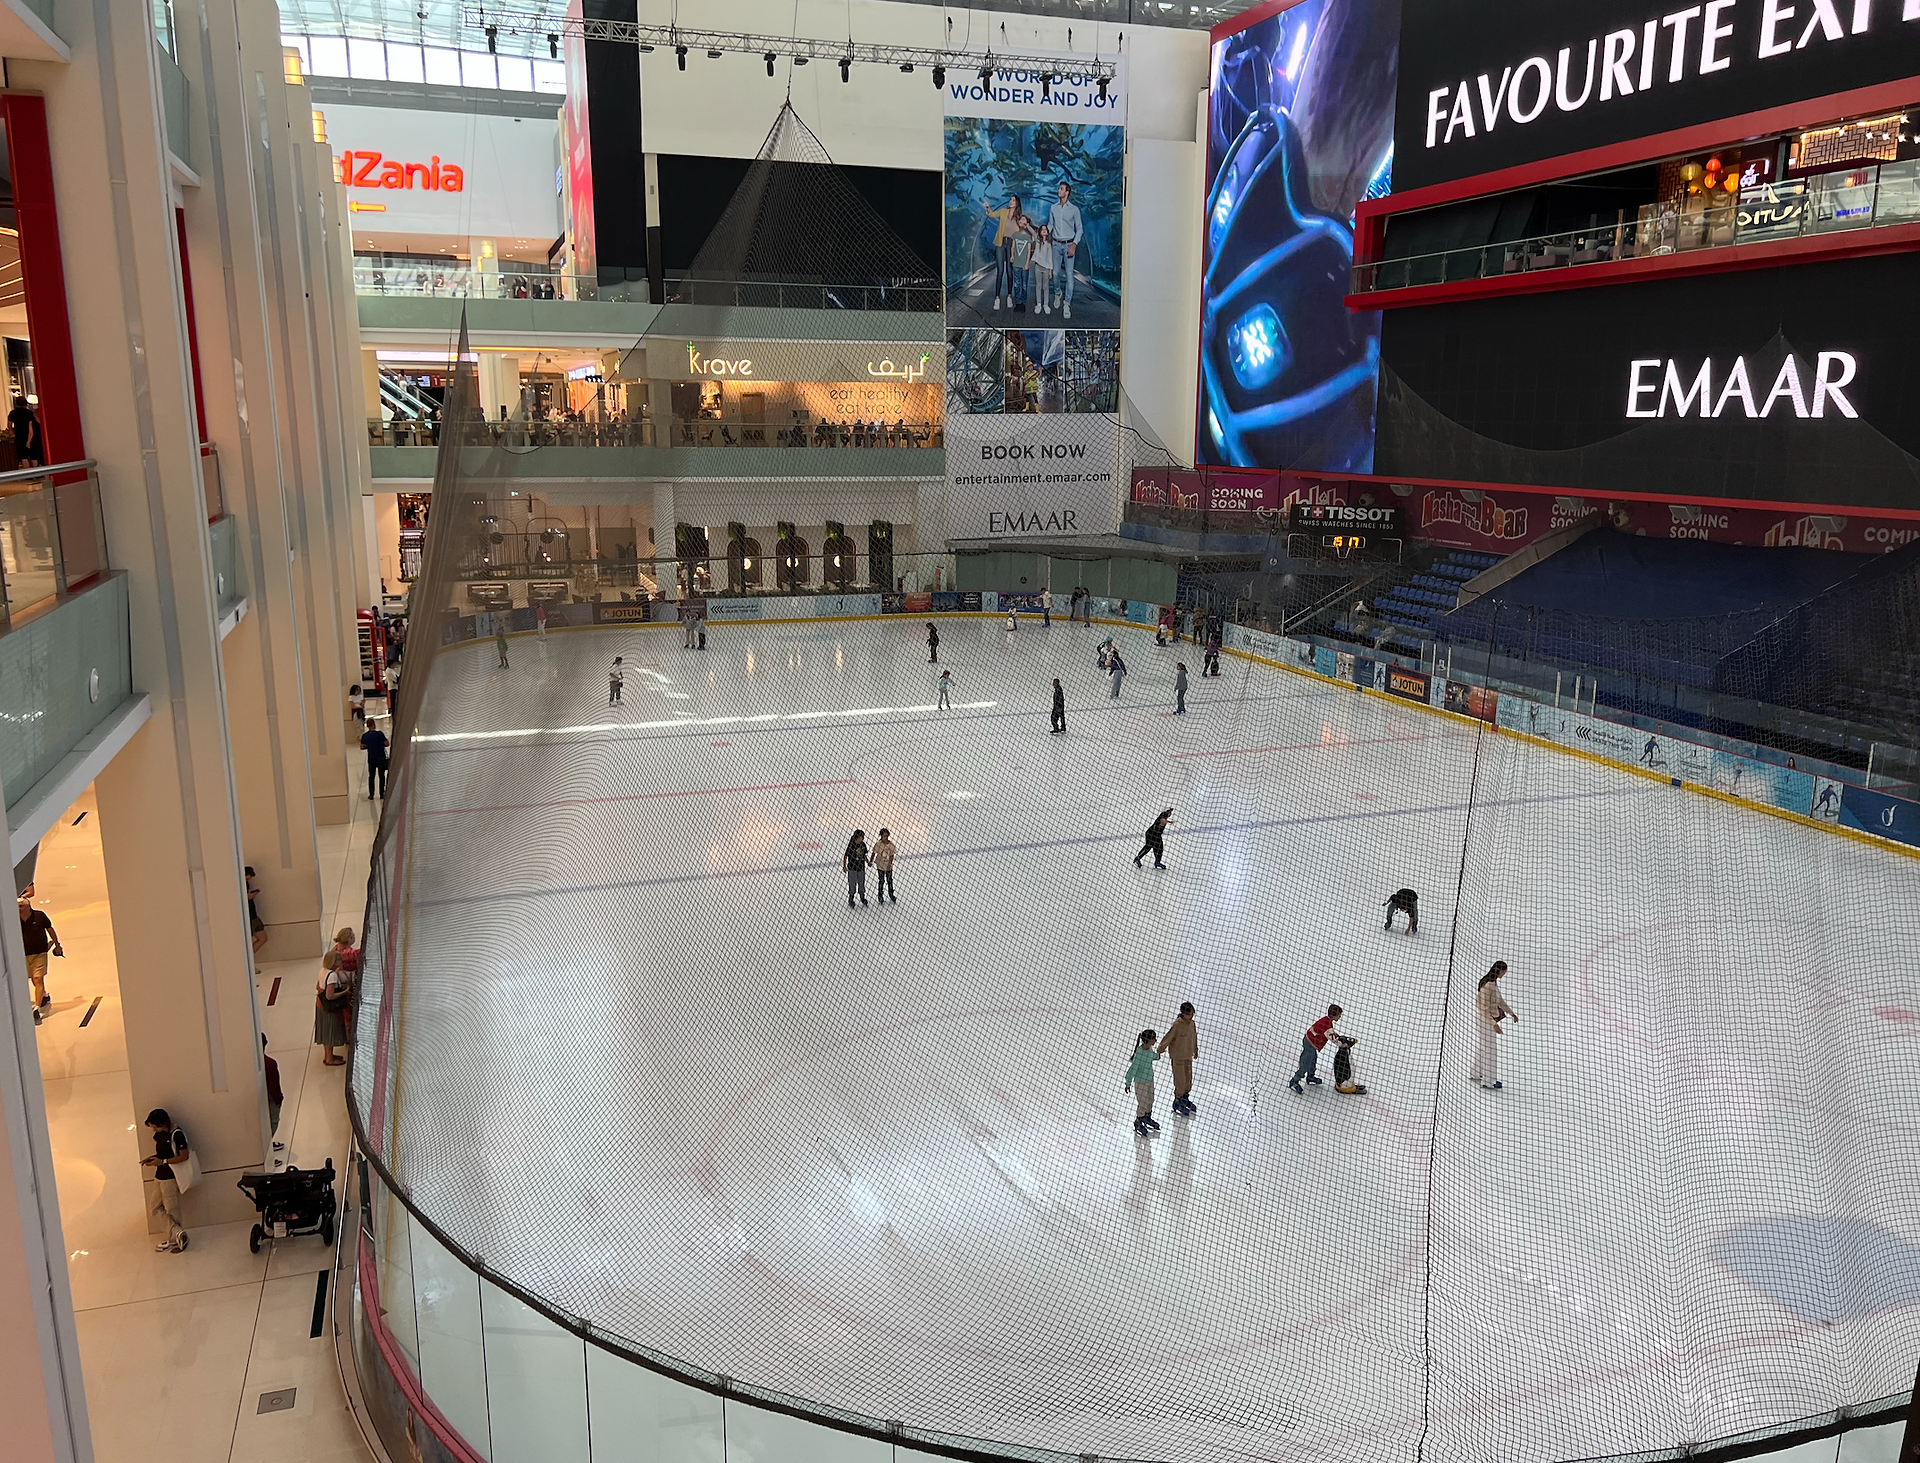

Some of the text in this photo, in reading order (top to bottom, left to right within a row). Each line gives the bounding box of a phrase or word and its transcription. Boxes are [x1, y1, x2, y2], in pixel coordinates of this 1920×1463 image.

[997, 69, 1064, 85] WORD
[1070, 73, 1093, 87] OF
[1425, 0, 1920, 148] FAVOURITE EX
[951, 84, 1118, 109] WONDER AND JOY
[1626, 351, 1858, 418] EMAAR
[981, 444, 1086, 460] BOOK NOW
[955, 471, 1111, 485] entertainment.emaar.com
[1211, 488, 1264, 499] COMING
[1210, 499, 1247, 510] SOON
[1421, 490, 1462, 528] Masha
[1325, 506, 1395, 521] TISSOT
[988, 510, 1078, 533] EMAAR
[1298, 519, 1320, 527] SWISS
[1321, 520, 1354, 528] WATCHES
[1550, 516, 1577, 528] SOO
[1669, 526, 1709, 540] SOON
[612, 609, 642, 618] JOTUN
[1398, 678, 1424, 694] JOTUN
